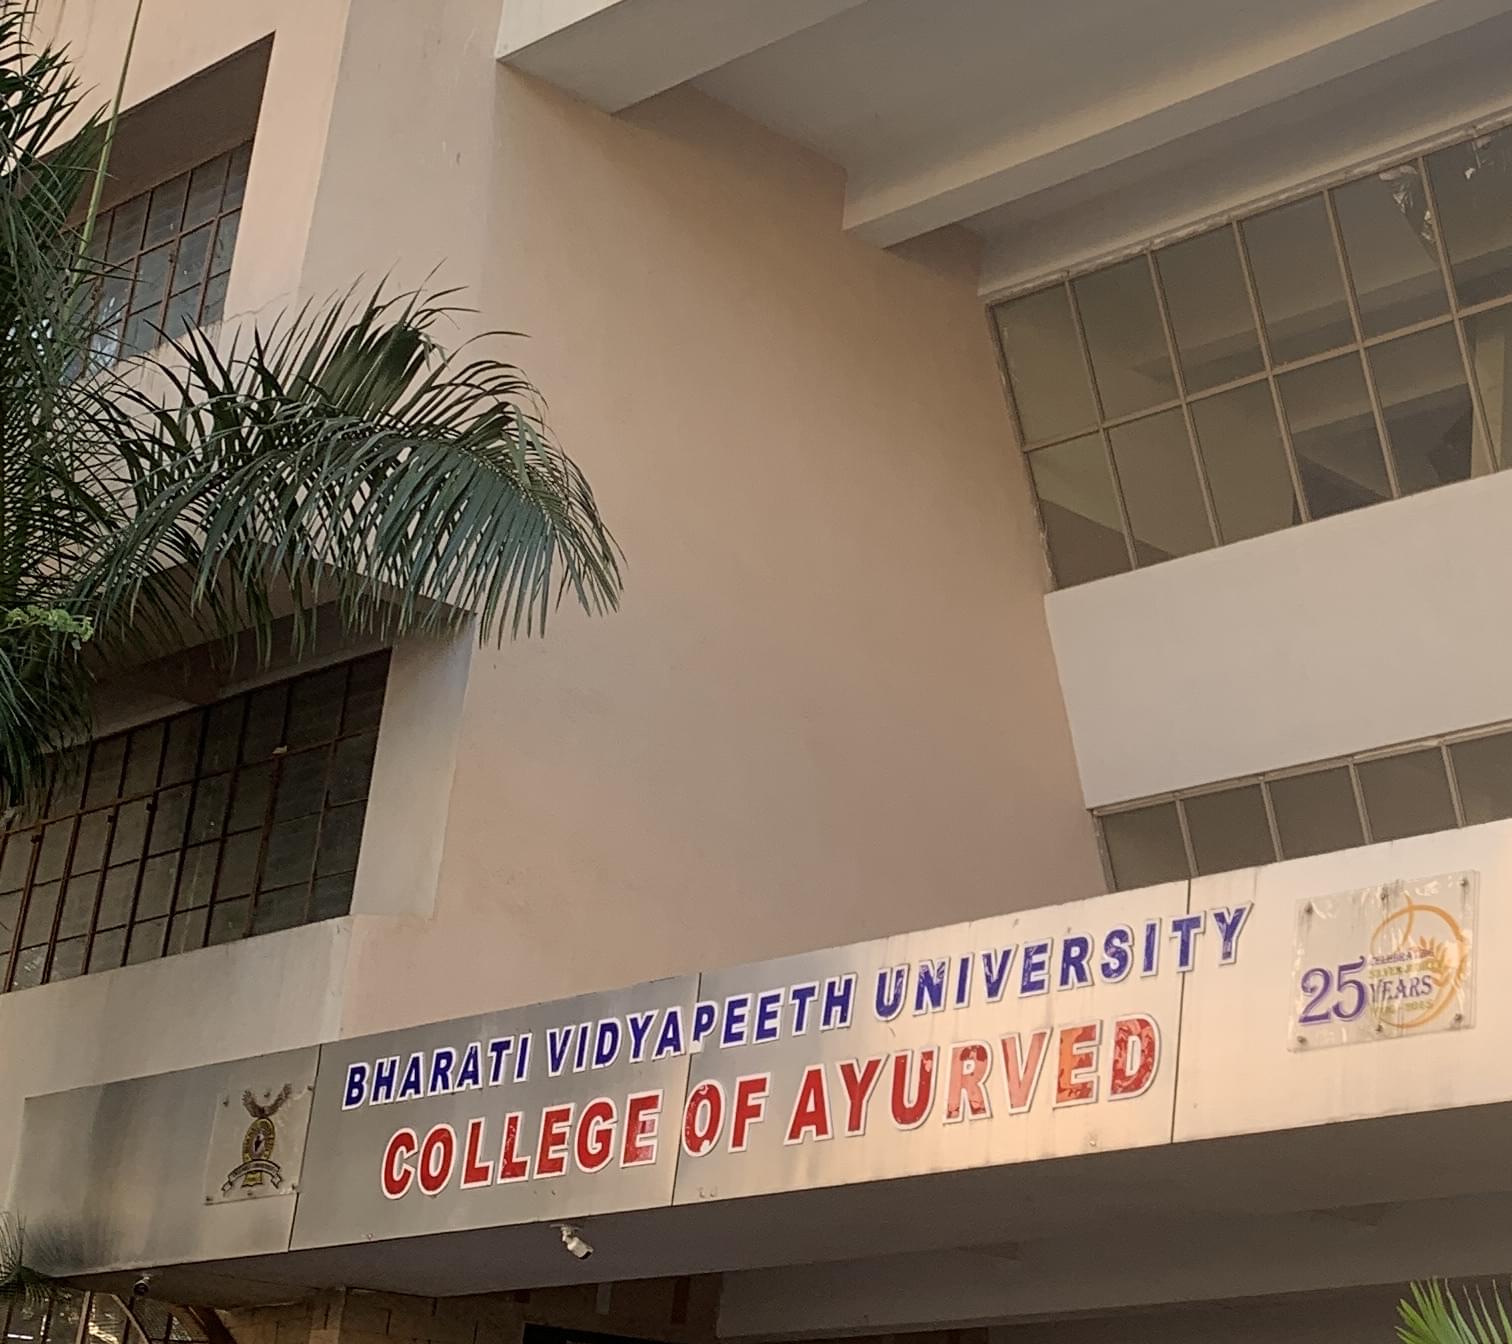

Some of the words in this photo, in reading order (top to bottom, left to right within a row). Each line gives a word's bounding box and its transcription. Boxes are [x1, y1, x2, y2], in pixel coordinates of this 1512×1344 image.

[340, 1033, 533, 1111] BHARATI
[546, 973, 855, 1078] VIDYAPEETH
[874, 901, 1256, 1021] UNIVERSITY
[1298, 955, 1367, 1026] 25
[1370, 975, 1434, 1004] YEARS
[381, 1089, 665, 1200] COLLEGE
[681, 1072, 772, 1157] OF
[784, 1013, 1161, 1145] AYURVED
